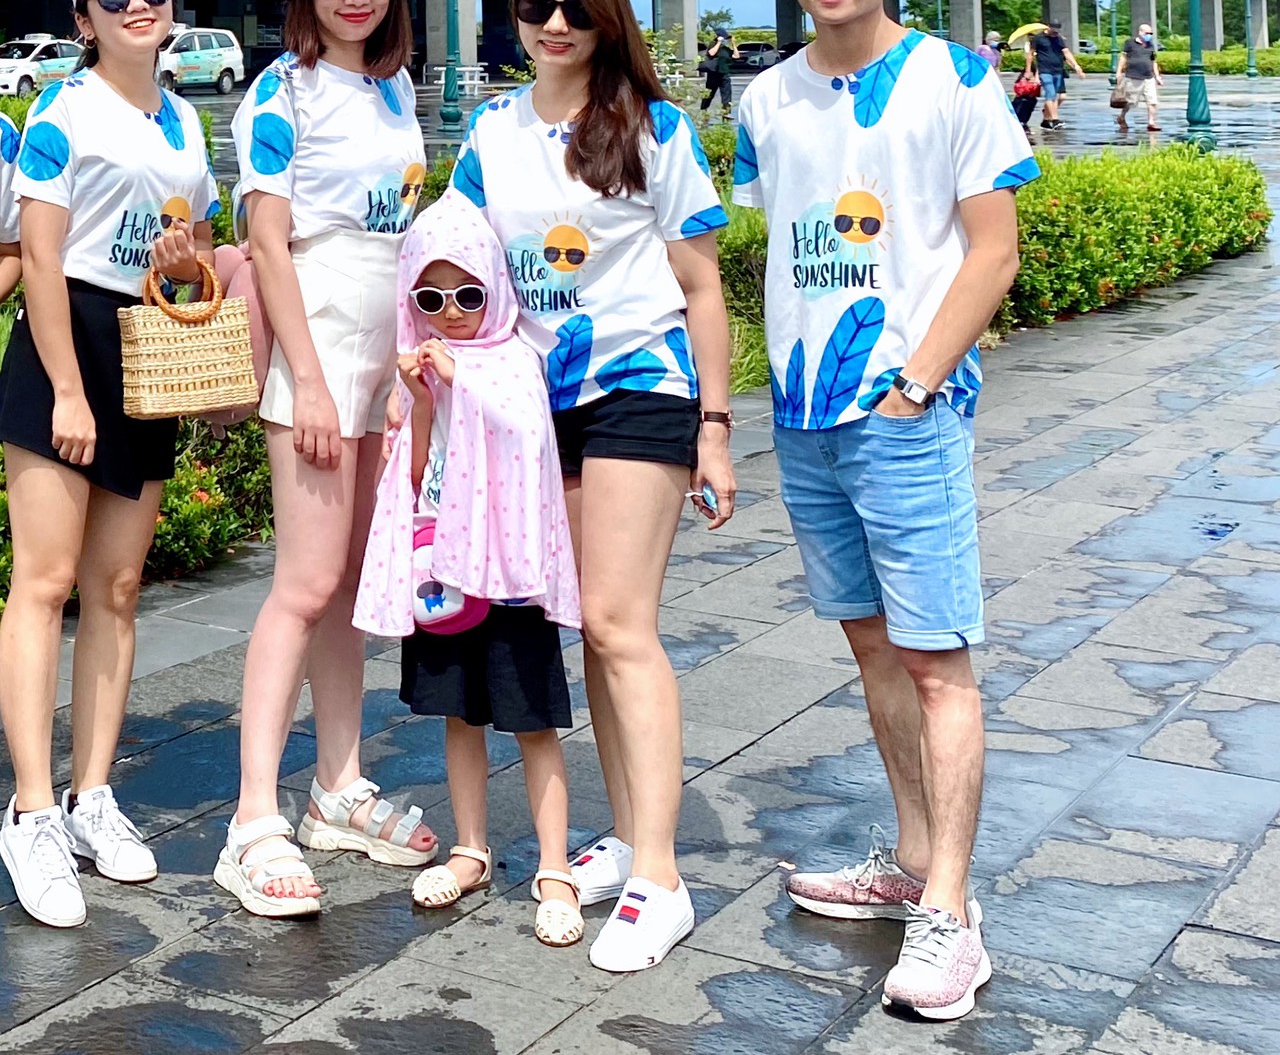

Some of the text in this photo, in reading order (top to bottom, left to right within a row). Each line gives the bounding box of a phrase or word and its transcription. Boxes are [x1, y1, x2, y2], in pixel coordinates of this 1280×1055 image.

[791, 220, 839, 259] Hello
[108, 244, 151, 269] SUNS
[793, 261, 882, 289] SUNSHINE
